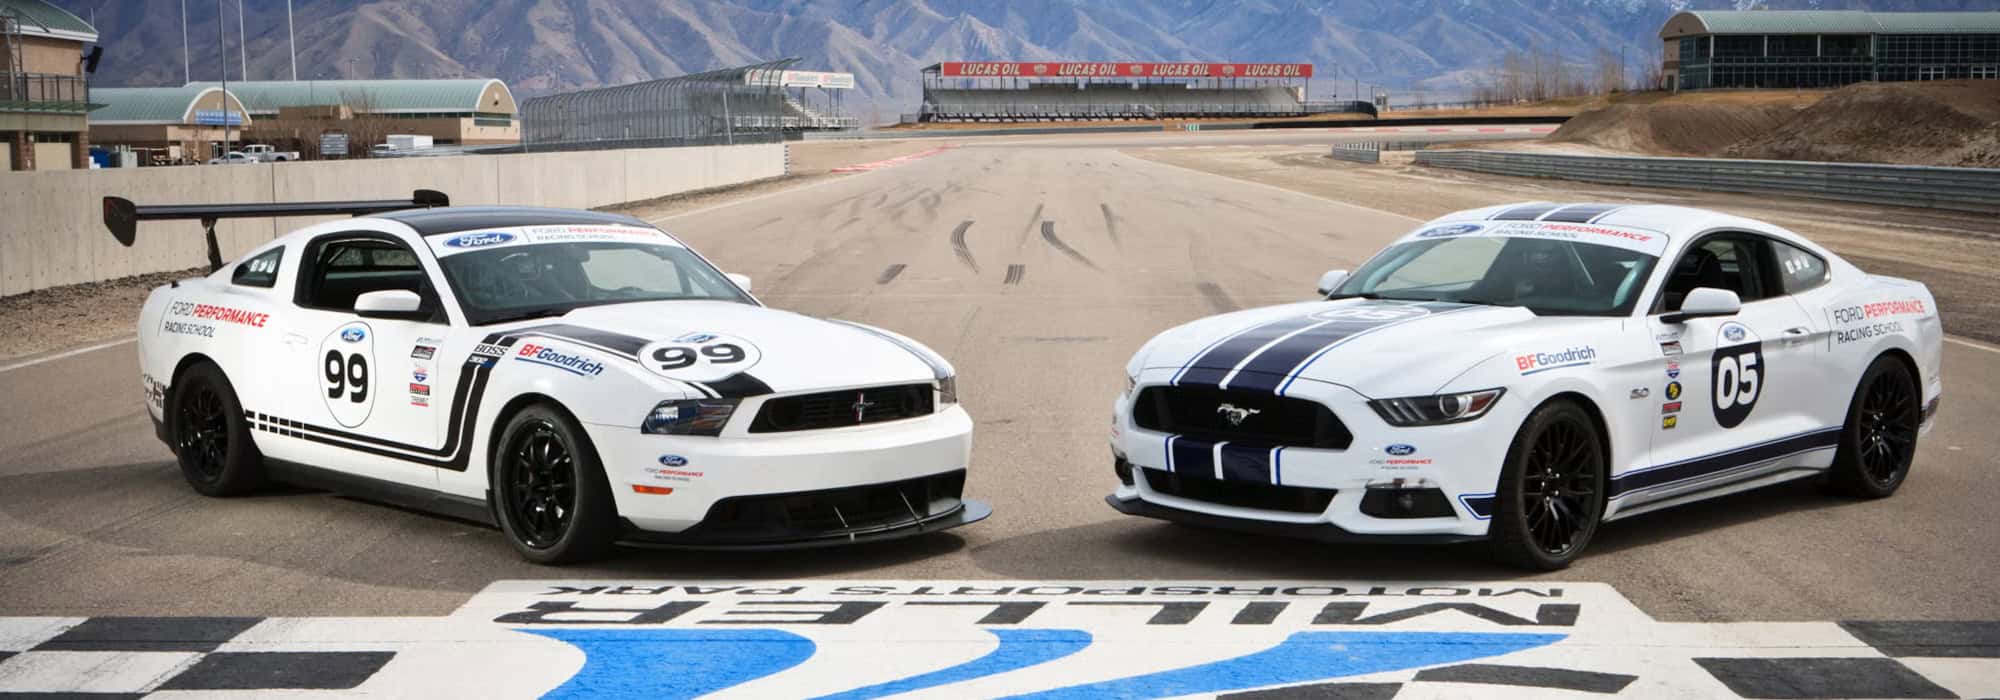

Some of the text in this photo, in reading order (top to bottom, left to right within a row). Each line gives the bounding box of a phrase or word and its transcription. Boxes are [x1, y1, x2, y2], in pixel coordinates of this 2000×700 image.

[960, 64, 1021, 75] LUCAS OIL
[1058, 64, 1117, 75] LUCAS OIL
[1152, 64, 1209, 76] LUCAS OIL
[1245, 64, 1301, 76] LUCAS OIL
[460, 232, 504, 247] Ford
[1541, 224, 1652, 242] PERFORMANCE
[170, 301, 270, 328] FORD PERFORMANCE
[1834, 299, 1925, 324] FORD PERFORMANCE
[164, 321, 216, 338] RACING SCHOOL
[1838, 321, 1904, 344] RACING SCHOOL
[474, 343, 508, 356] BOSS
[517, 343, 605, 376] BFGoodrich
[652, 343, 746, 371] 99
[1516, 345, 1596, 371] BFGoodrich
[325, 349, 369, 403] 99
[1717, 352, 1758, 410] 05
[538, 585, 1563, 597] MOTORSPORTS PARK
[494, 600, 1580, 627] MILLER
